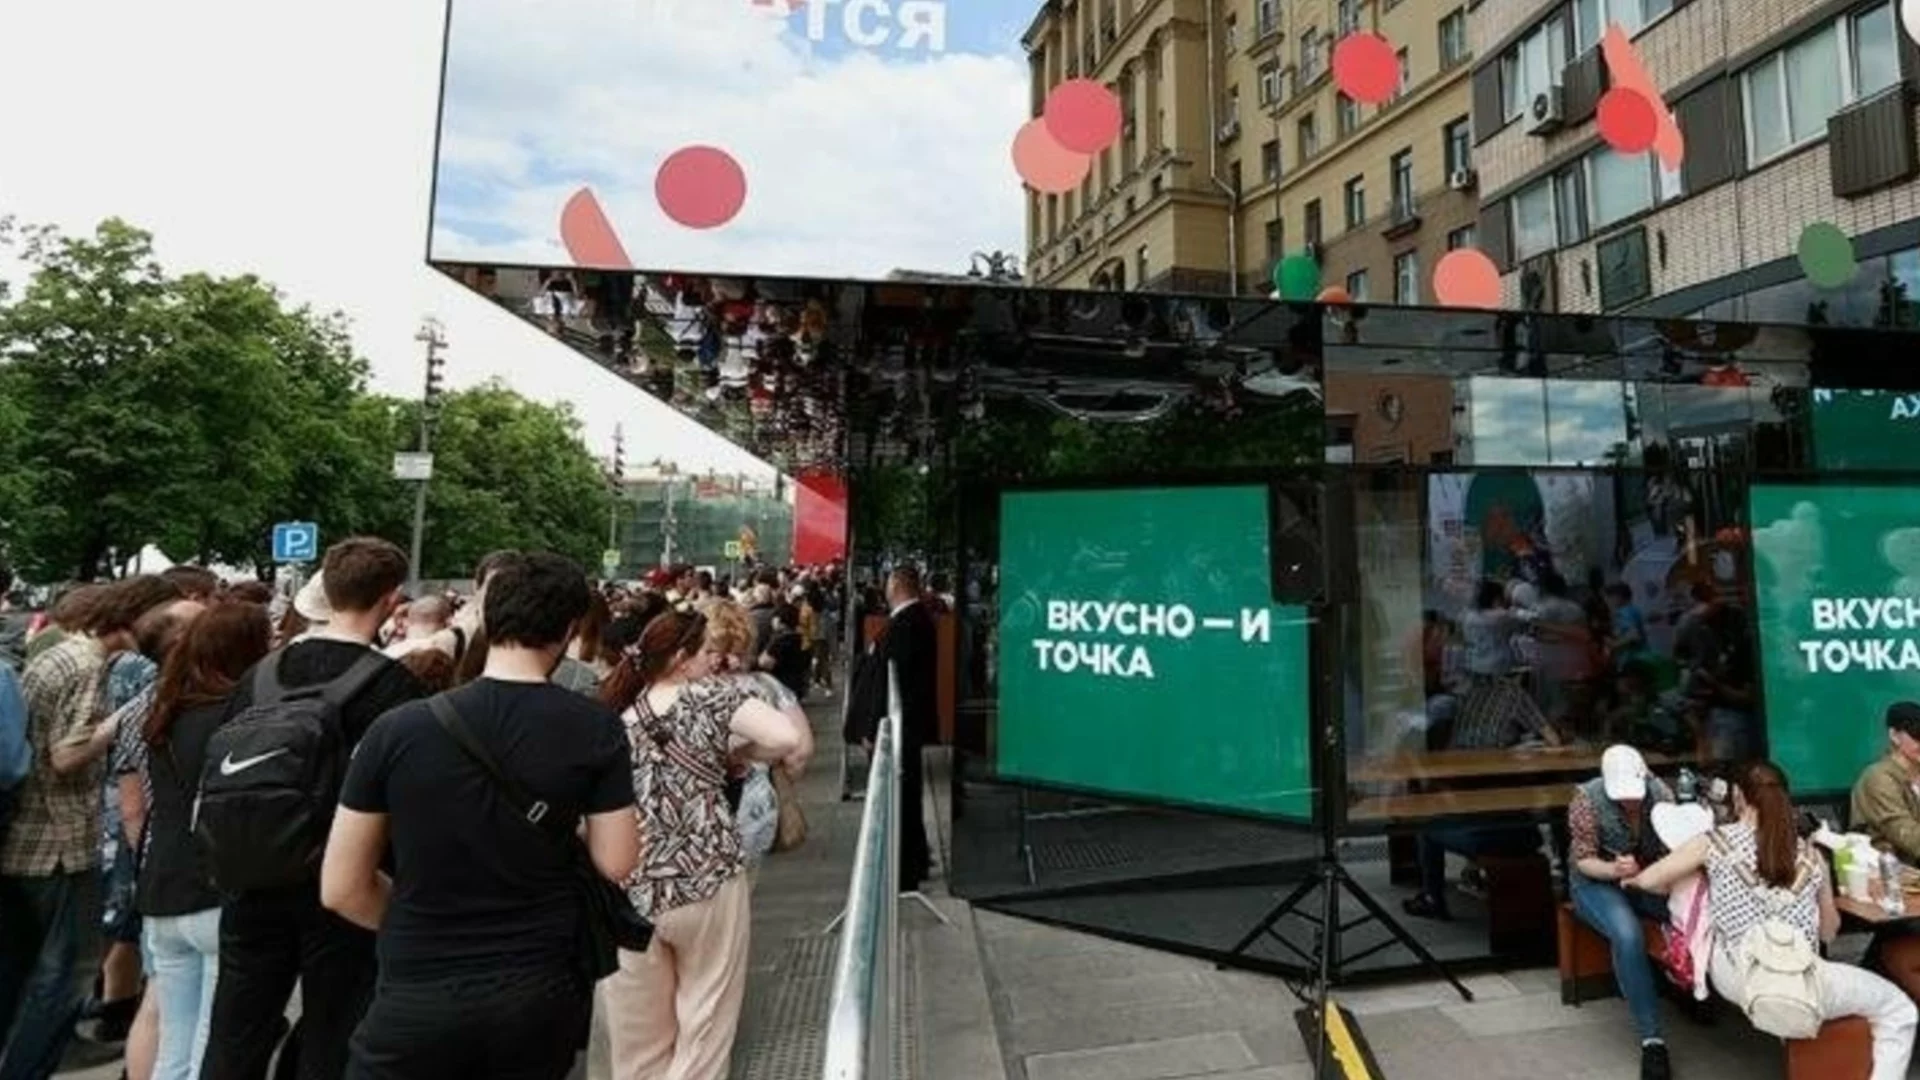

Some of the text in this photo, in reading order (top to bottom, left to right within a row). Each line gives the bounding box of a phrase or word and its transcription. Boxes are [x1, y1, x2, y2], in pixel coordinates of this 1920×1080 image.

[1047, 600, 1195, 638] ВКУСНО
[1240, 608, 1270, 643] И
[1032, 639, 1154, 678] ТОЧКА
[1799, 639, 1920, 673] ТОЧКА
